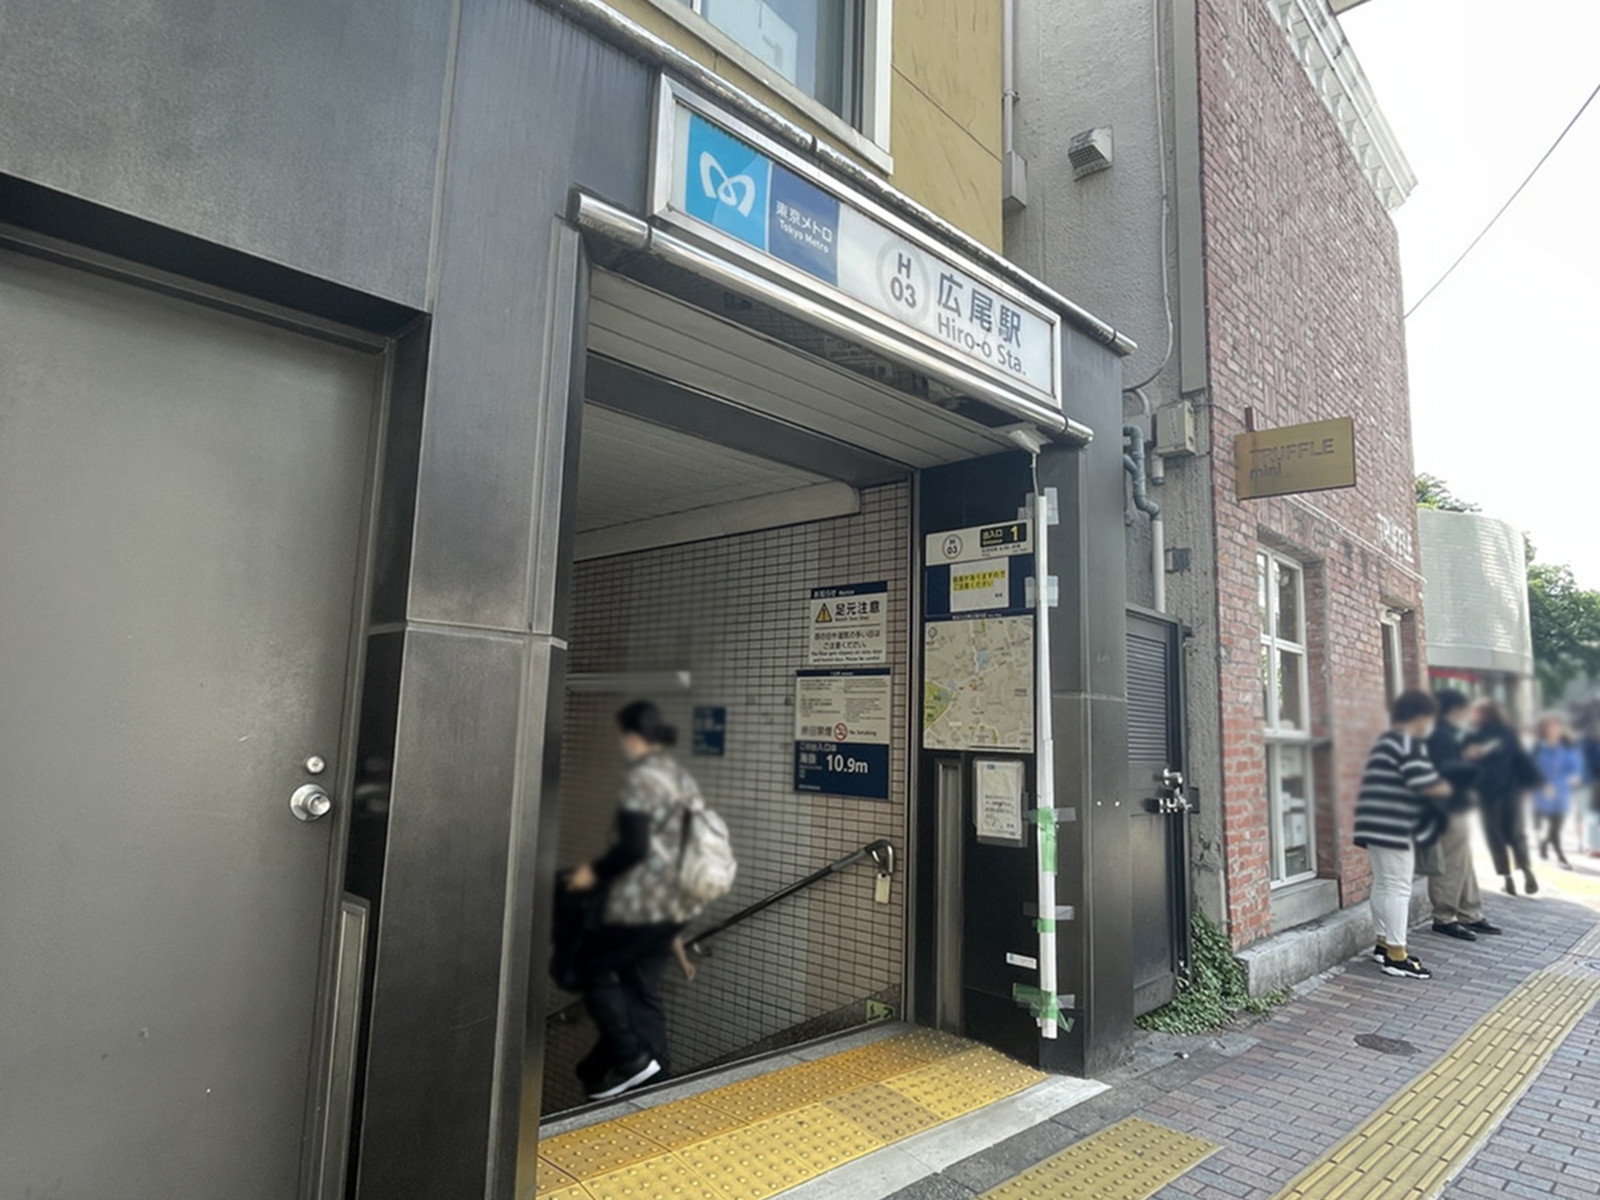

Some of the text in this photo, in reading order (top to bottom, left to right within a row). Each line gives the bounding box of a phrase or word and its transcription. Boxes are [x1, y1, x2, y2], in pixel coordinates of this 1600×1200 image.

[776, 200, 833, 243] 東京メトロ
[780, 218, 829, 254] Tokyo Metro
[897, 252, 911, 279] H
[890, 276, 917, 309] 03
[937, 272, 1021, 349] 広尾駅
[937, 312, 1027, 376] Hiro-o Sta.
[1249, 437, 1334, 467] TRUFFLE
[1250, 463, 1282, 479] mini
[1011, 525, 1019, 541] 1
[836, 600, 880, 616] 足元注意
[826, 754, 869, 774] 10.9m
